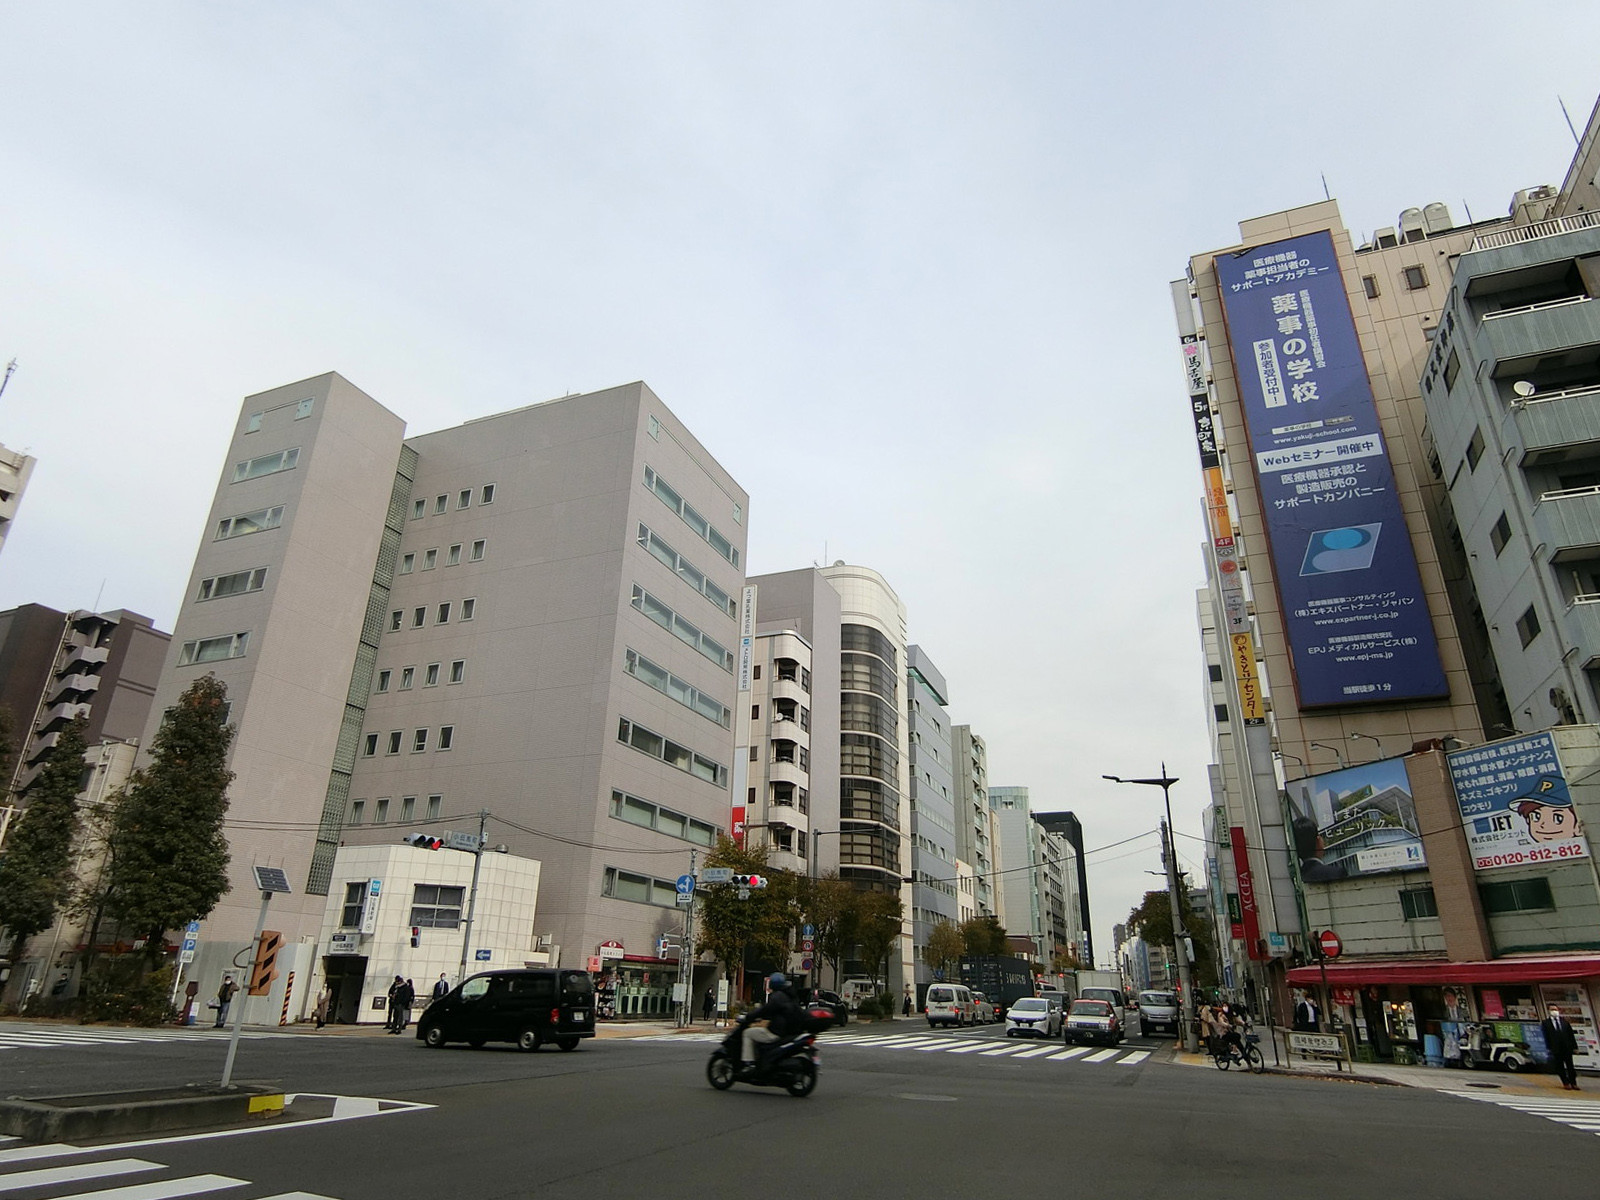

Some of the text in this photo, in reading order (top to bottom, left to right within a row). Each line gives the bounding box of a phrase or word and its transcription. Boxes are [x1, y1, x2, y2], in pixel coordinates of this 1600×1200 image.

[1253, 251, 1297, 268] 医療機器
[1231, 267, 1329, 292] サポートアカデミー
[1270, 293, 1320, 403] 薬事の学校
[1281, 463, 1367, 485] 医療機器承認と
[1296, 477, 1358, 494] 製造販売の
[1274, 487, 1385, 510] サポートカンパニー
[1217, 537, 1231, 546] 4F
[1233, 617, 1243, 625] 3F
[1463, 801, 1492, 813] コウモリ
[1492, 815, 1513, 832] JET
[1493, 844, 1583, 865] 0120-812-812
[1239, 871, 1254, 912] ACCEA
